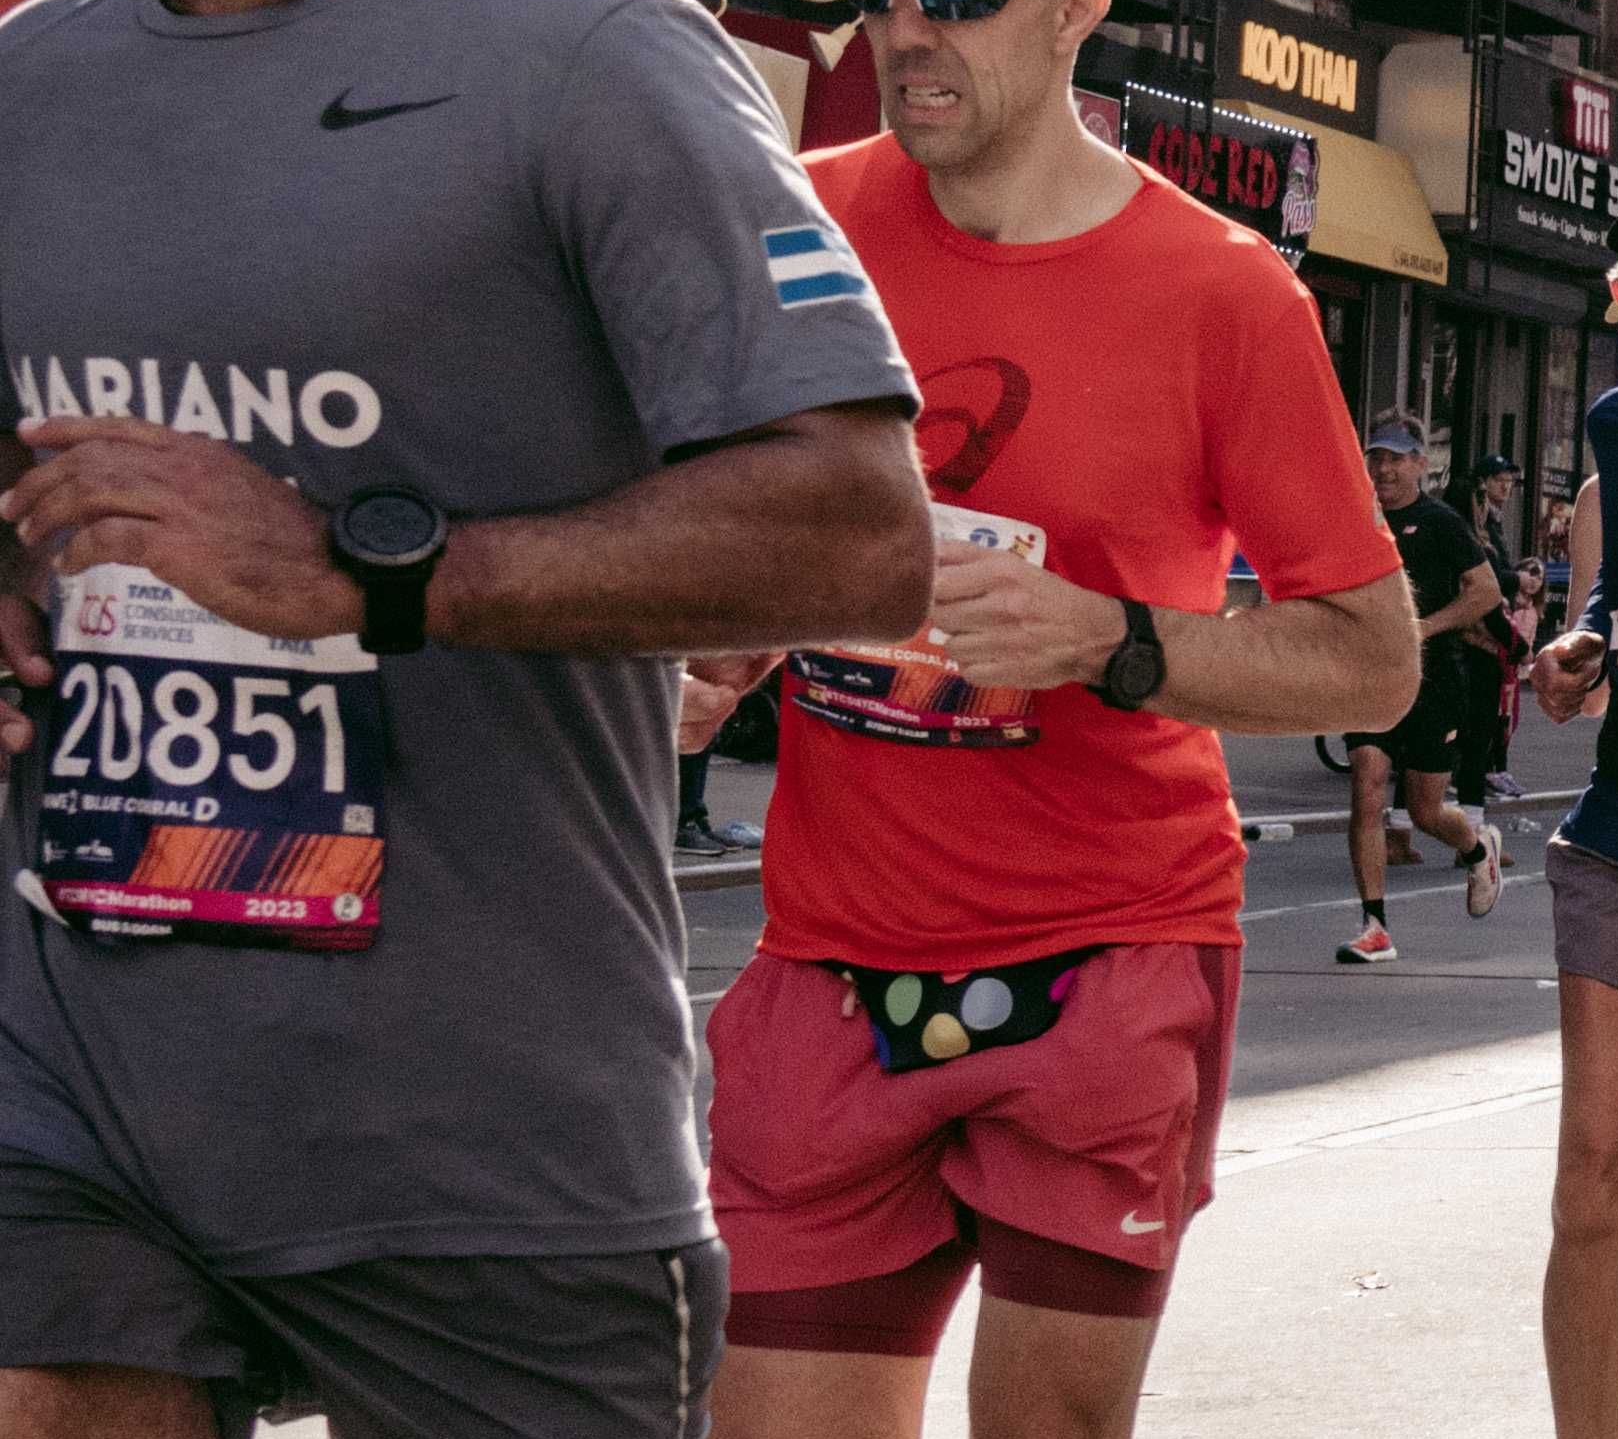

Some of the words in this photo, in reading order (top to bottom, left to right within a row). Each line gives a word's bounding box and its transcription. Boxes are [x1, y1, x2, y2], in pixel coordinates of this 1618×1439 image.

[1241, 21, 1298, 91] KOO
[1300, 42, 1357, 112] THAI
[1148, 120, 1222, 196] CODE
[1226, 135, 1279, 209] RED
[1504, 130, 1598, 210] SMOKE
[127, 583, 174, 602] TATA
[121, 623, 194, 644] SERVICES
[51, 662, 348, 794] 20851
[953, 715, 991, 727] 2023
[193, 796, 220, 822] D
[245, 898, 307, 919] 2023
